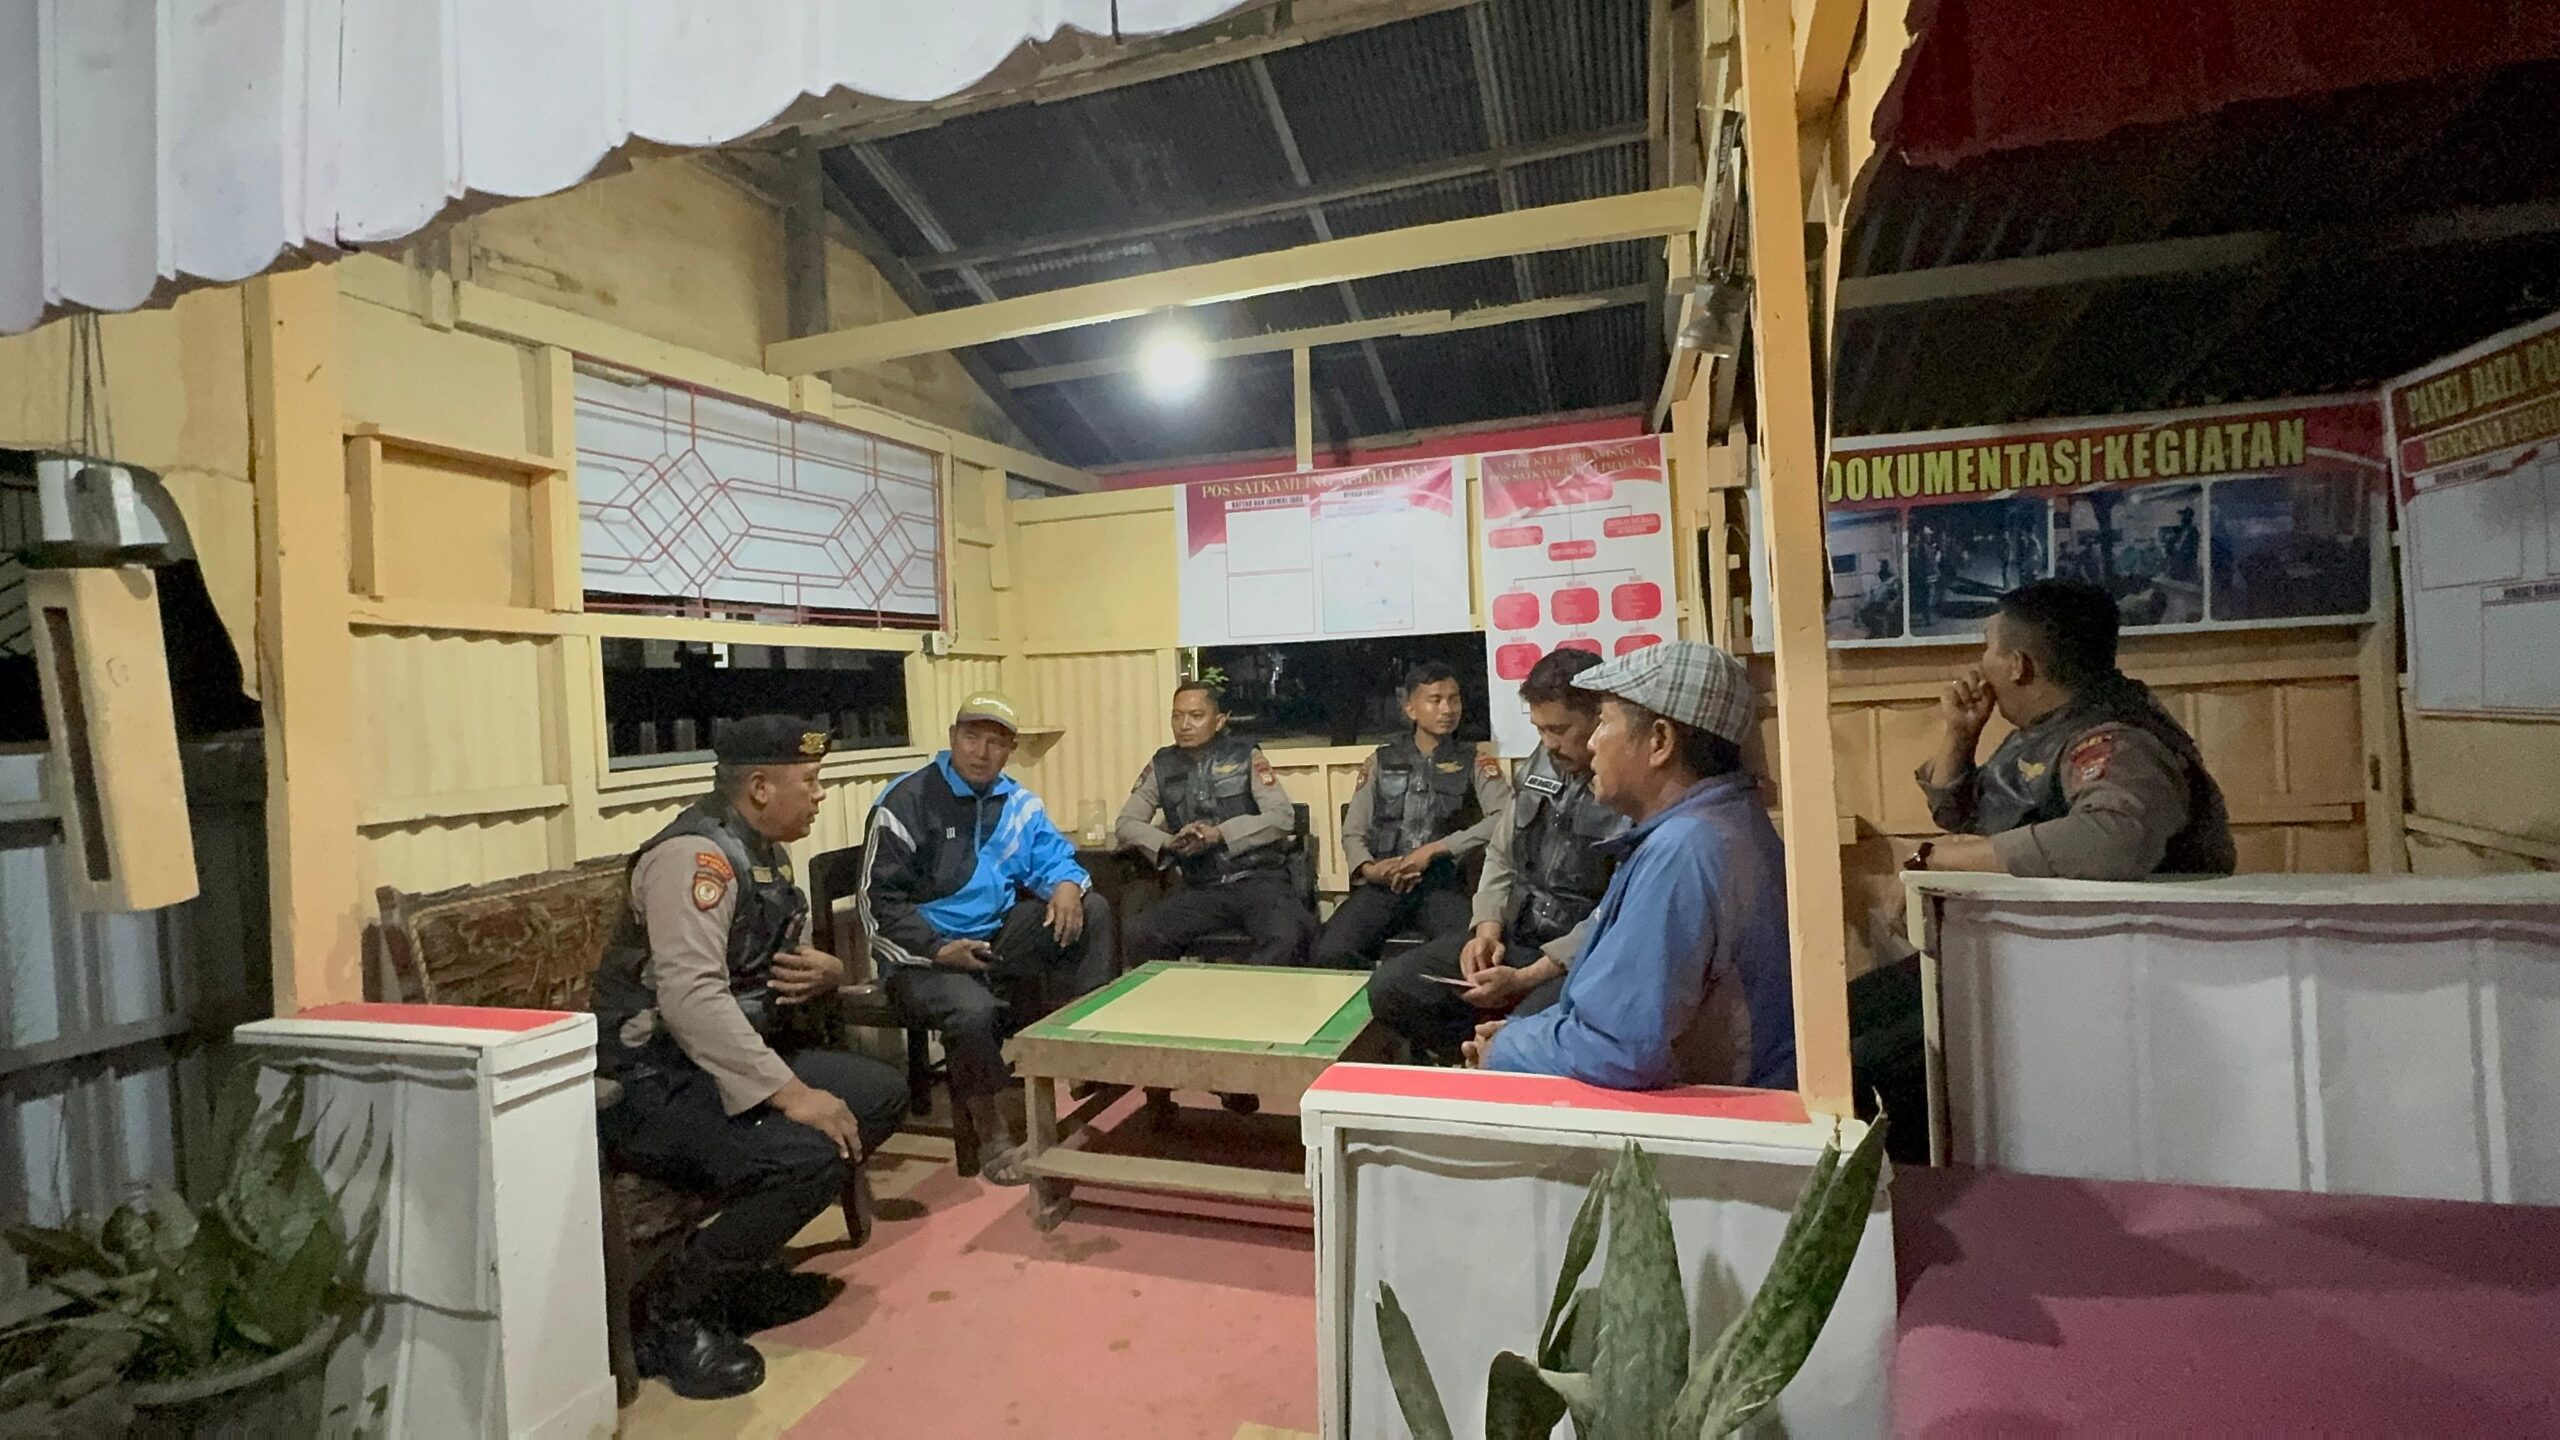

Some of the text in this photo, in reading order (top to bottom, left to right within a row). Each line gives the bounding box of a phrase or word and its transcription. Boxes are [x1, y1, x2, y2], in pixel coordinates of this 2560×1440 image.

[2406, 374, 2468, 428] PANEL
[2470, 352, 2528, 408] DATA
[1828, 418, 2305, 502] DOKUMENTASI KEGIATAN
[2425, 419, 2506, 464] RENCANA
[1201, 482, 1231, 499] POS
[1233, 475, 1334, 496] SATKAMLING
